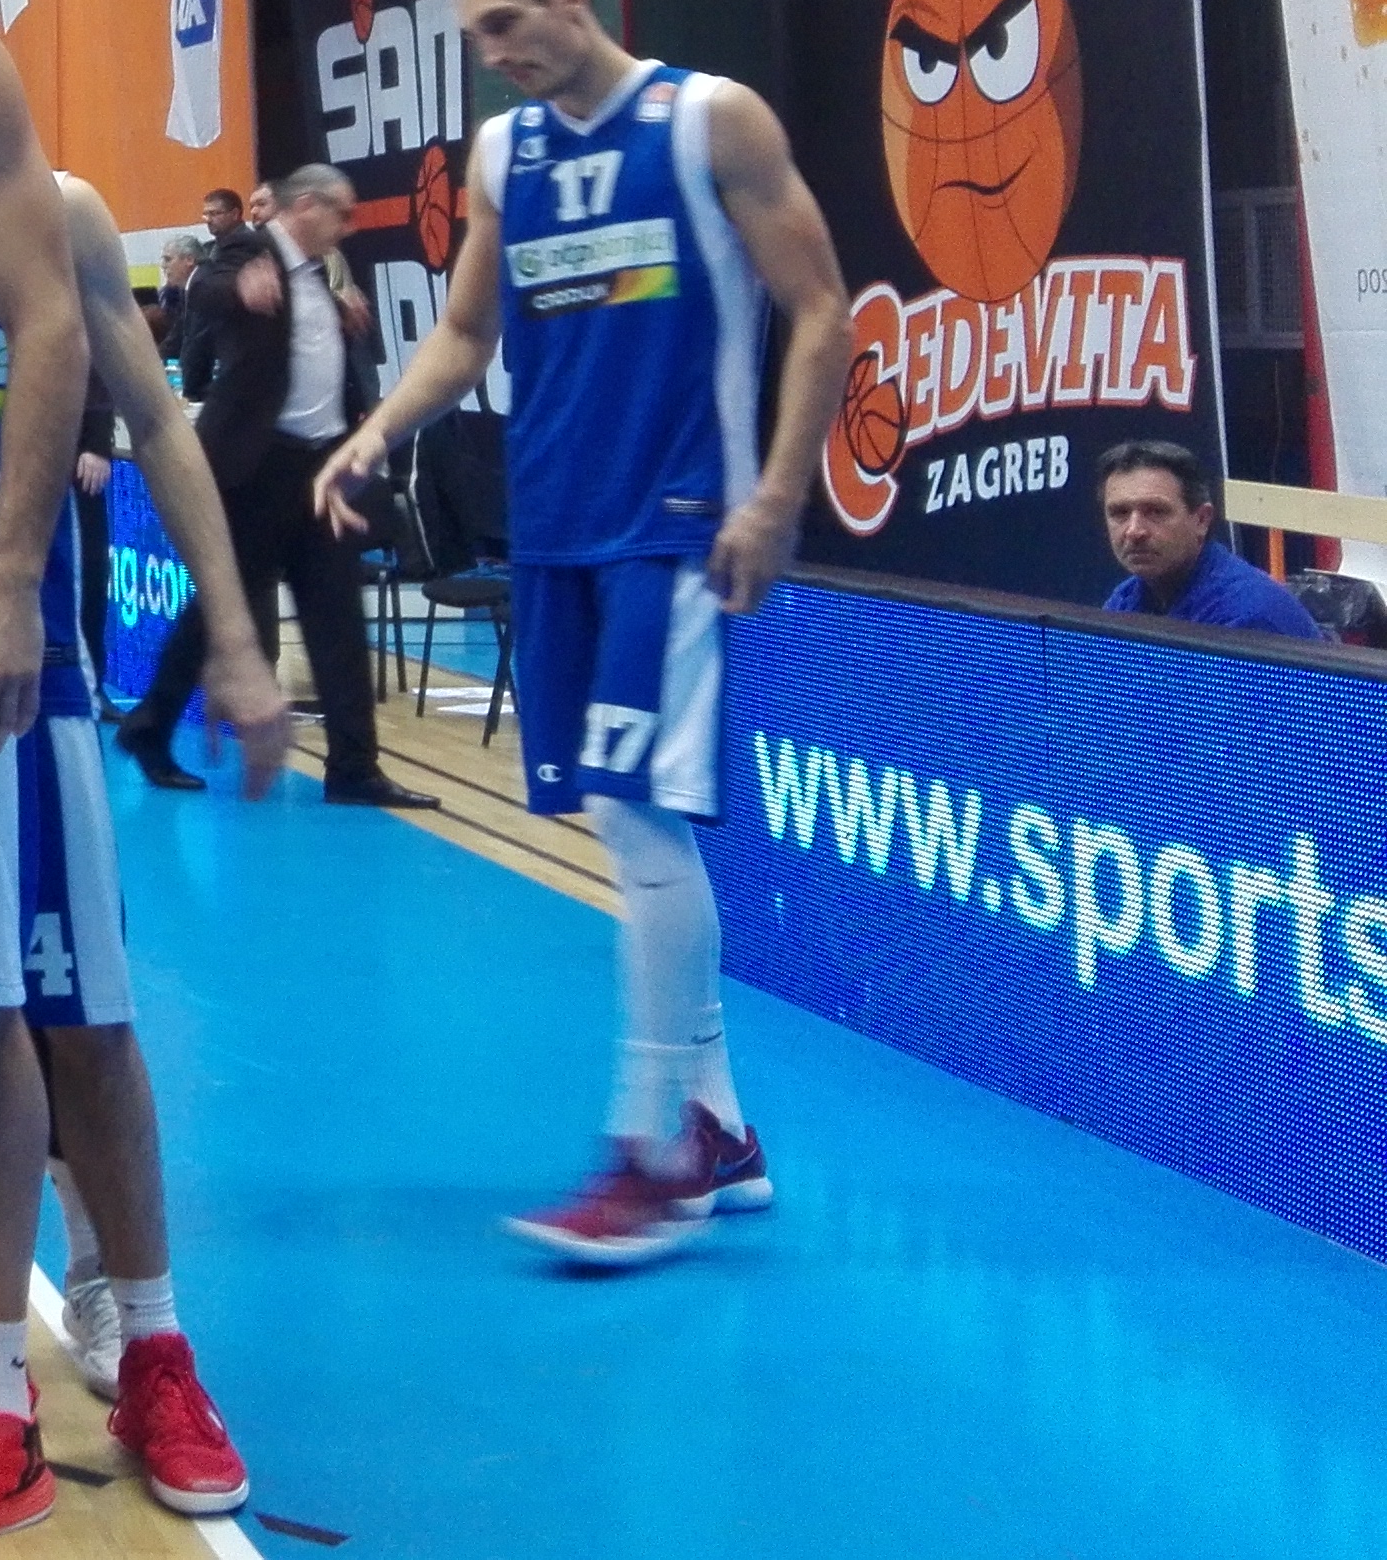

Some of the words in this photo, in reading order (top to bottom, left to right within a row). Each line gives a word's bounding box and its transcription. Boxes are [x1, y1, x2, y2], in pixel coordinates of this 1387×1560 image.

[549, 149, 624, 222] 17
[823, 255, 1197, 536] CEDEVITA
[925, 435, 1070, 513] ZAGREB
[579, 702, 660, 774] 17
